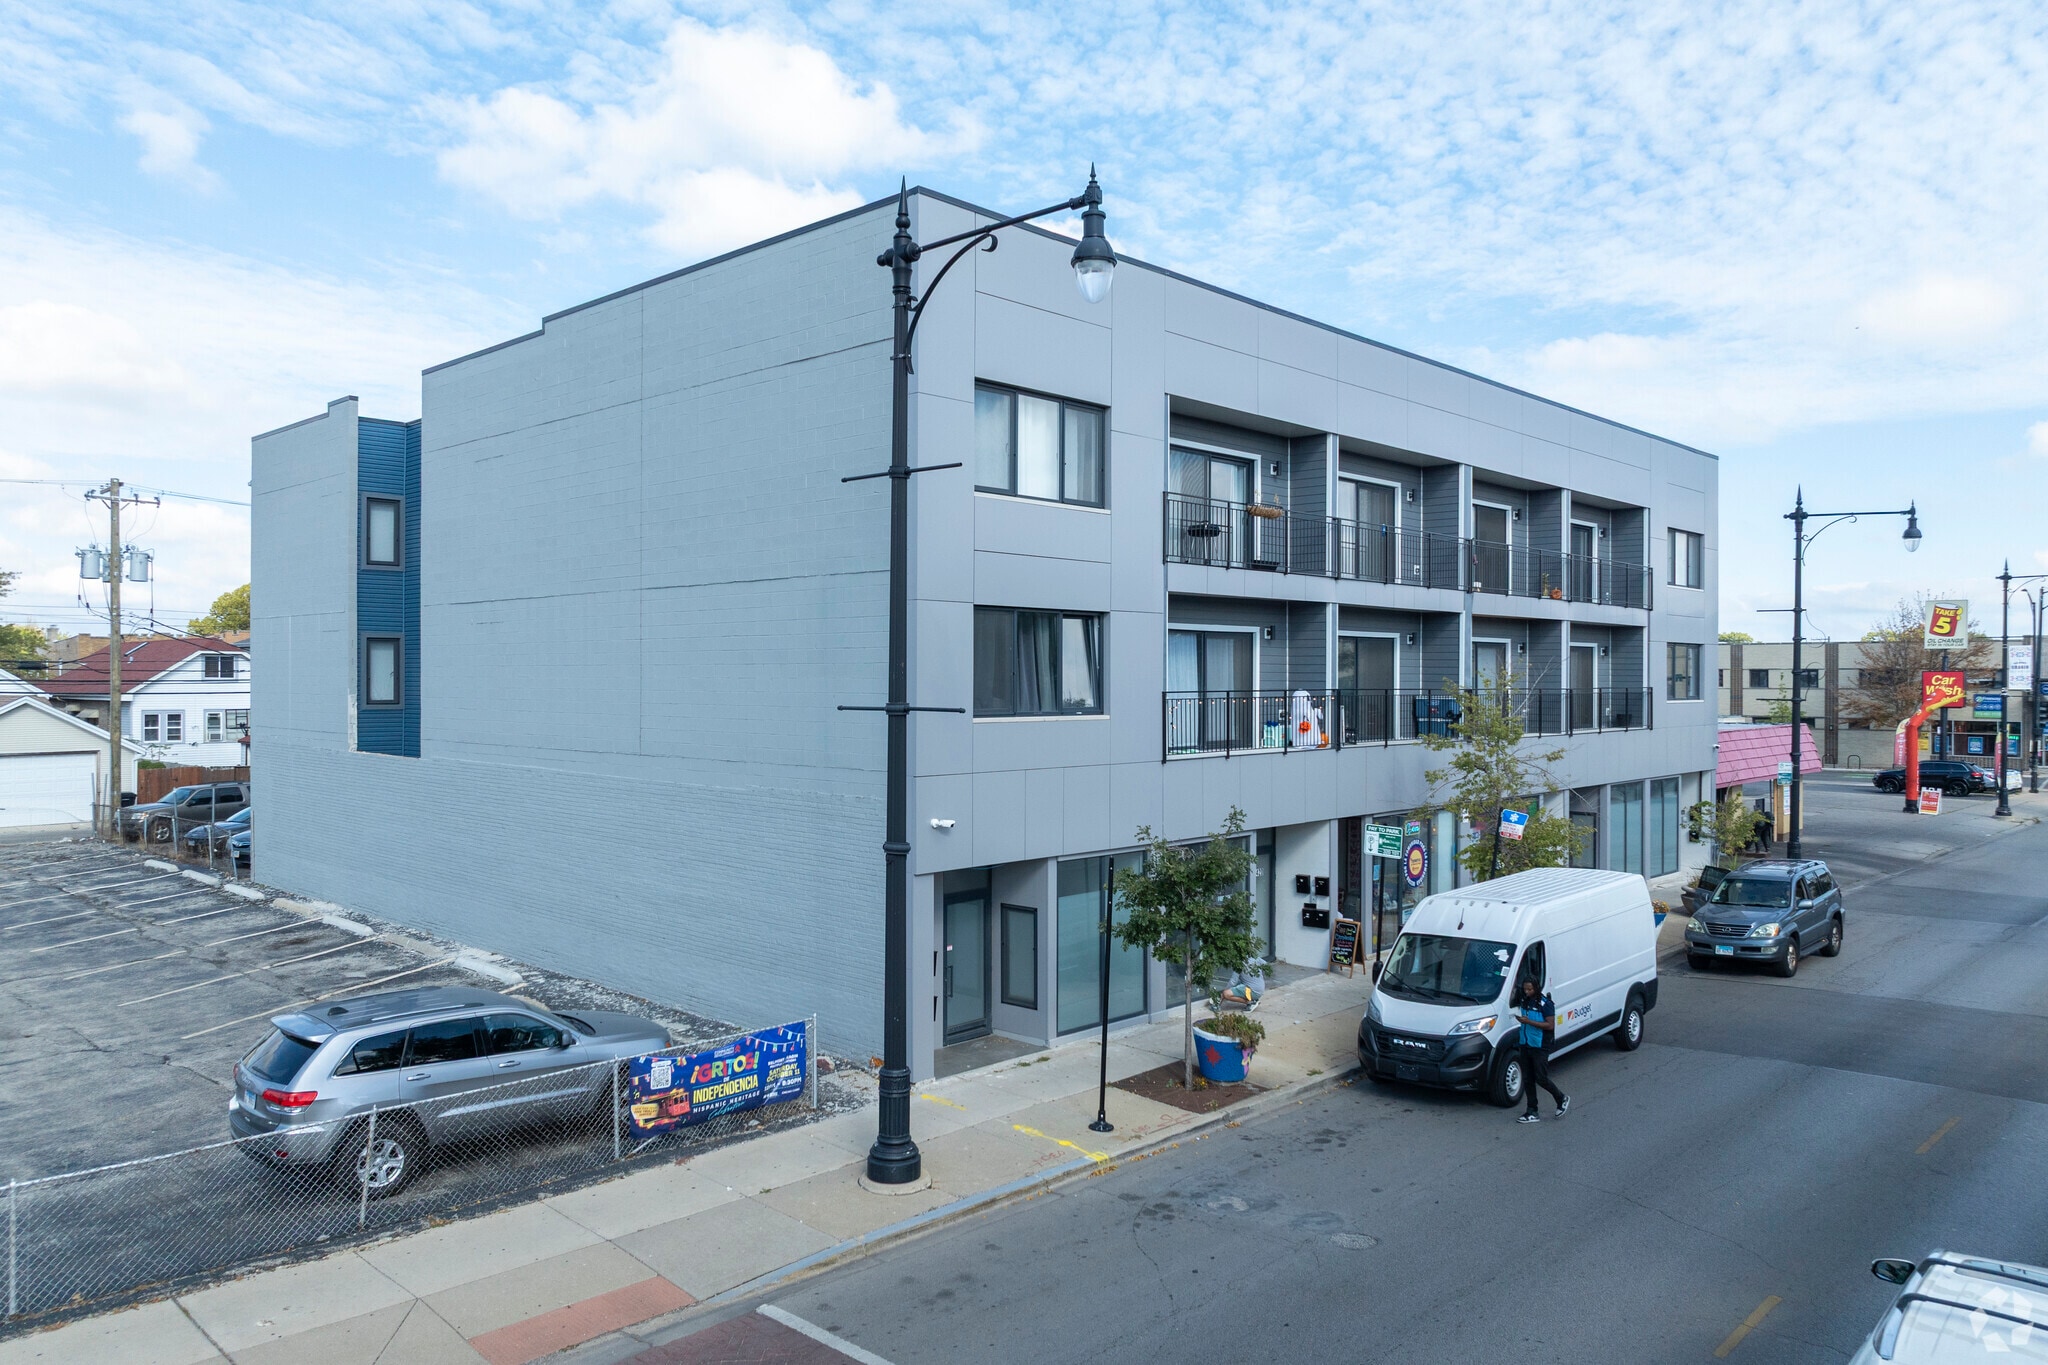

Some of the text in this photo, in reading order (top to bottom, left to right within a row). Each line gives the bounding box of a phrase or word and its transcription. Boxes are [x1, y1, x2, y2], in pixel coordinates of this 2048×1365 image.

[1935, 608, 1956, 616] TAKE
[1933, 617, 1951, 634] 5
[1931, 675, 1956, 685] Car
[1925, 686, 1962, 695] Wsh
[1574, 1003, 1592, 1019] Budget
[1393, 1039, 1426, 1049] RAM
[690, 1051, 760, 1084] ¡GRITOS!
[693, 1074, 759, 1104] INDEPENDENCIA
[693, 1100, 727, 1113] HISPANIC
[729, 1090, 760, 1104] HERITAGE
